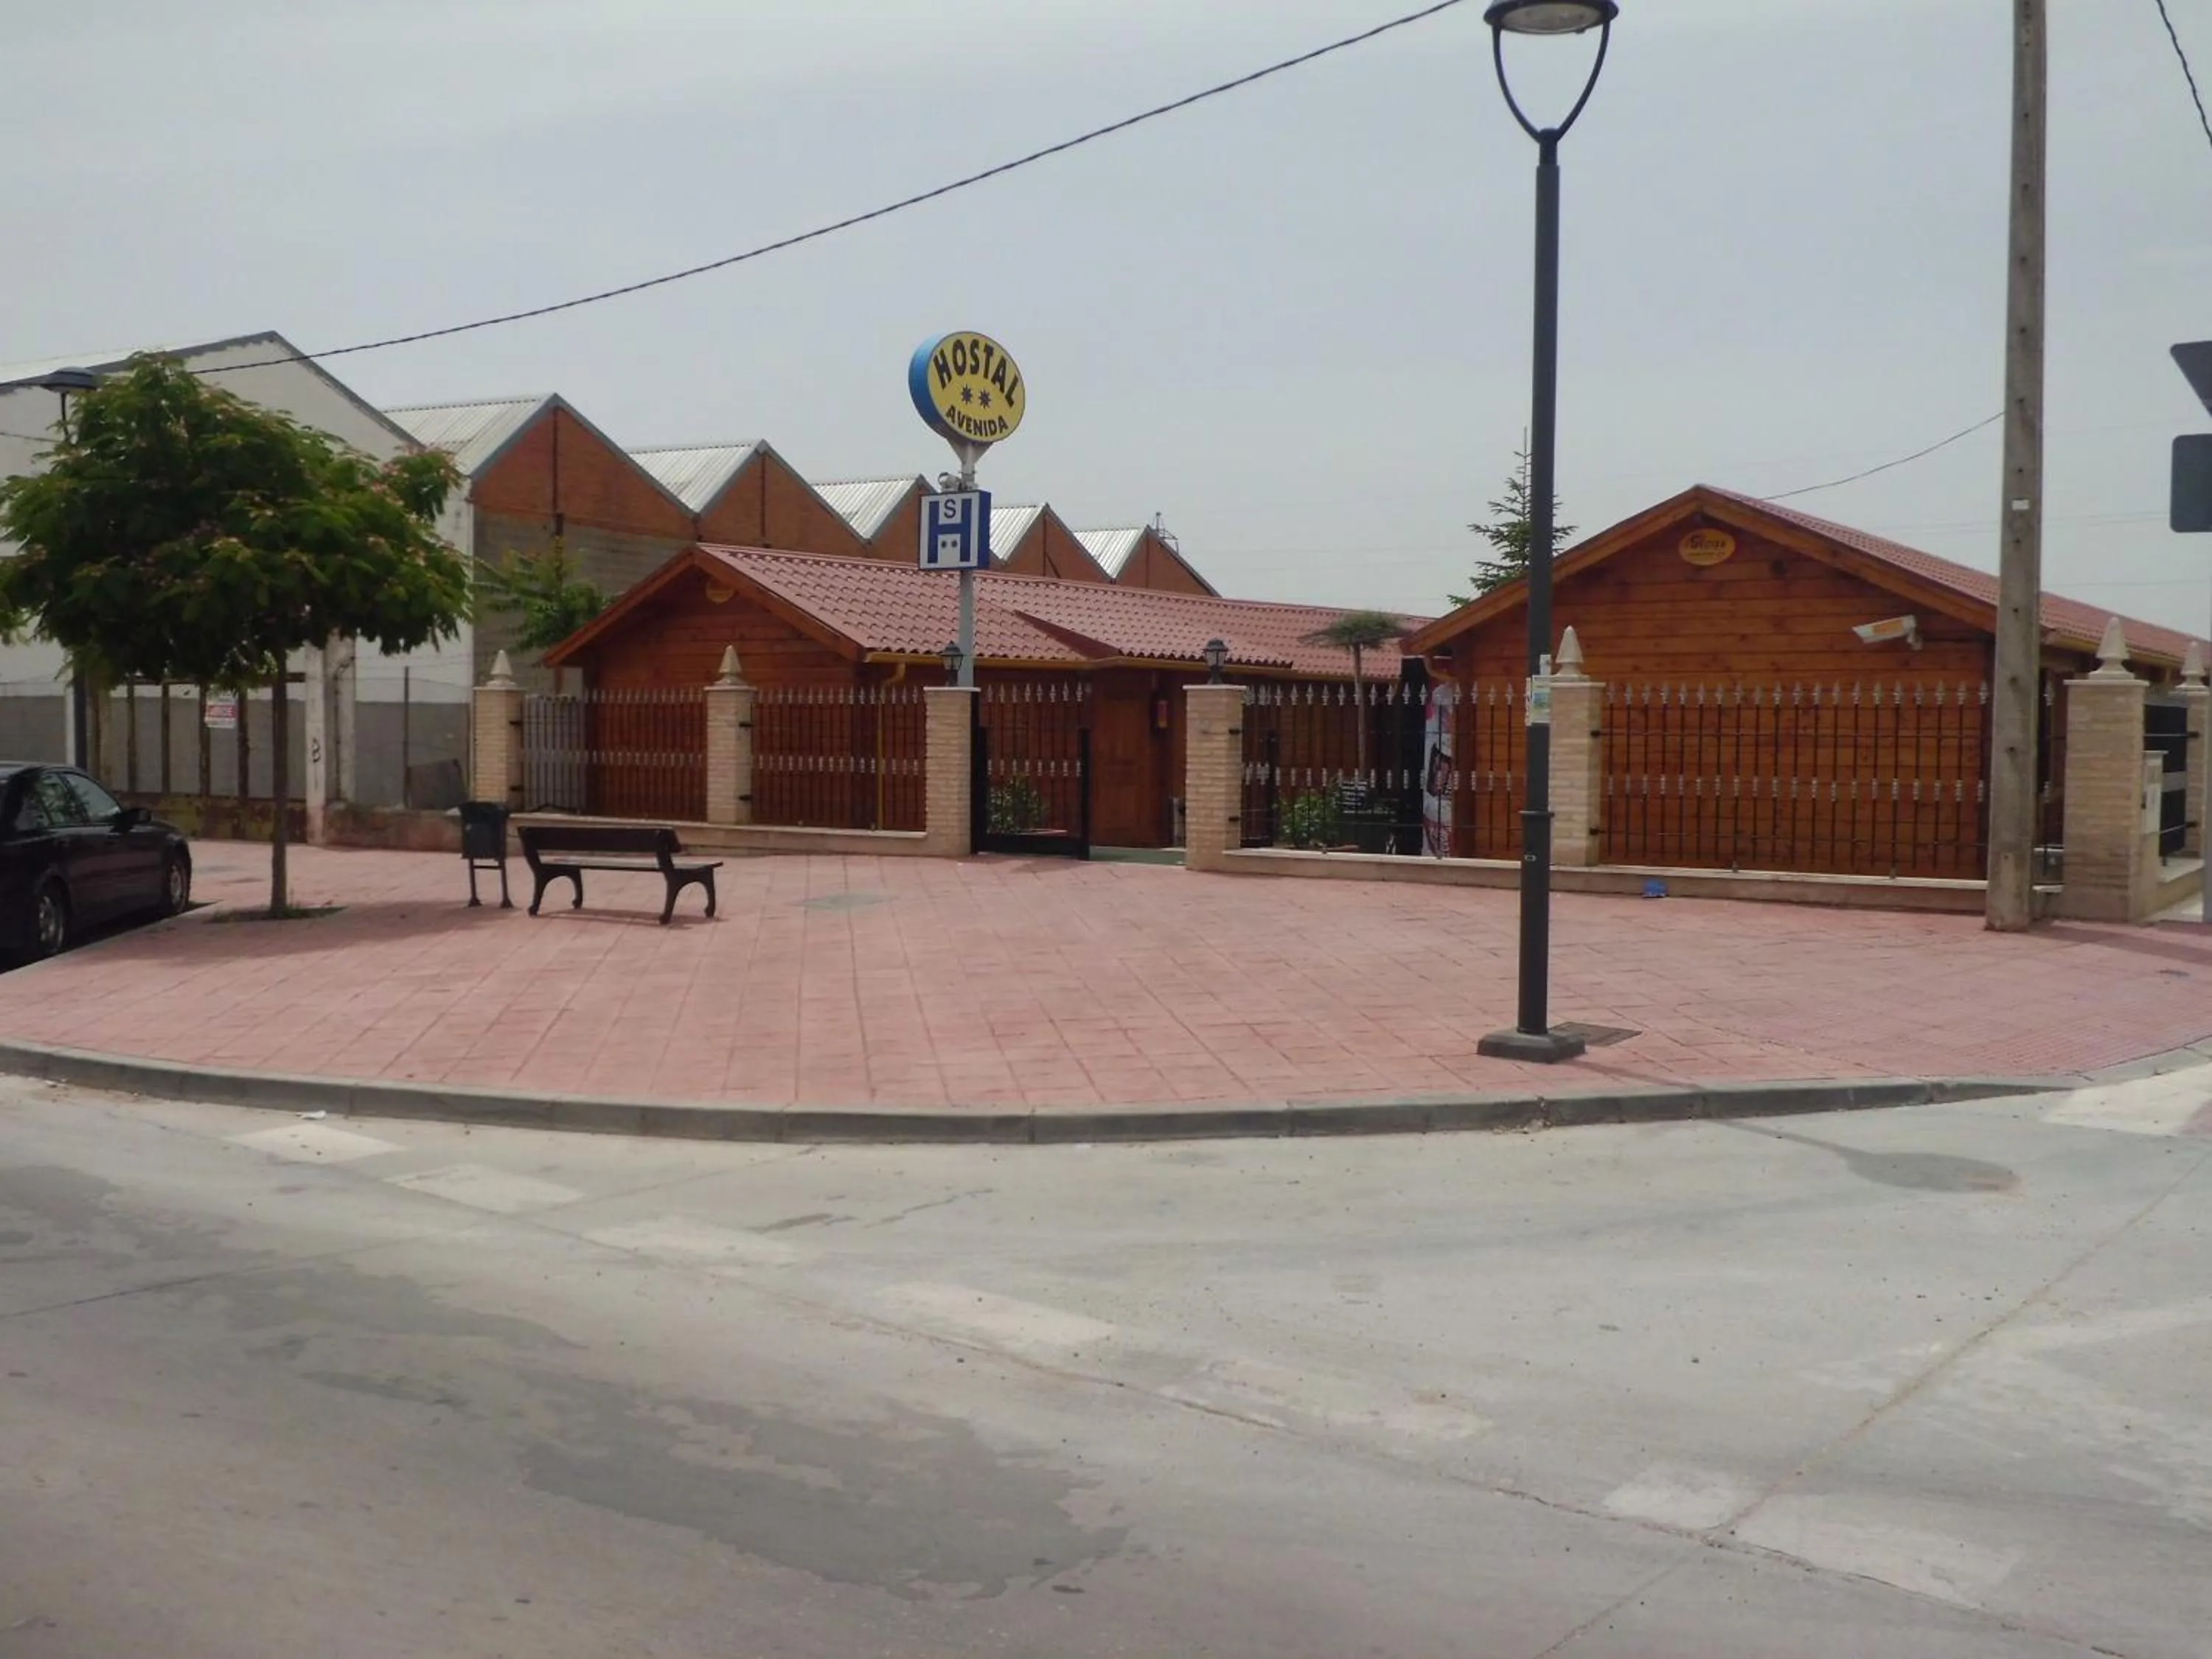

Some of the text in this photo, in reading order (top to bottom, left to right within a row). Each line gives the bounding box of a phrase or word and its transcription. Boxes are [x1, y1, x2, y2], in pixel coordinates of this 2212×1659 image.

[933, 338, 1020, 407] HOSTAL
[945, 405, 1009, 437] AVENIDA
[928, 498, 973, 564] H
[943, 499, 956, 518] S
